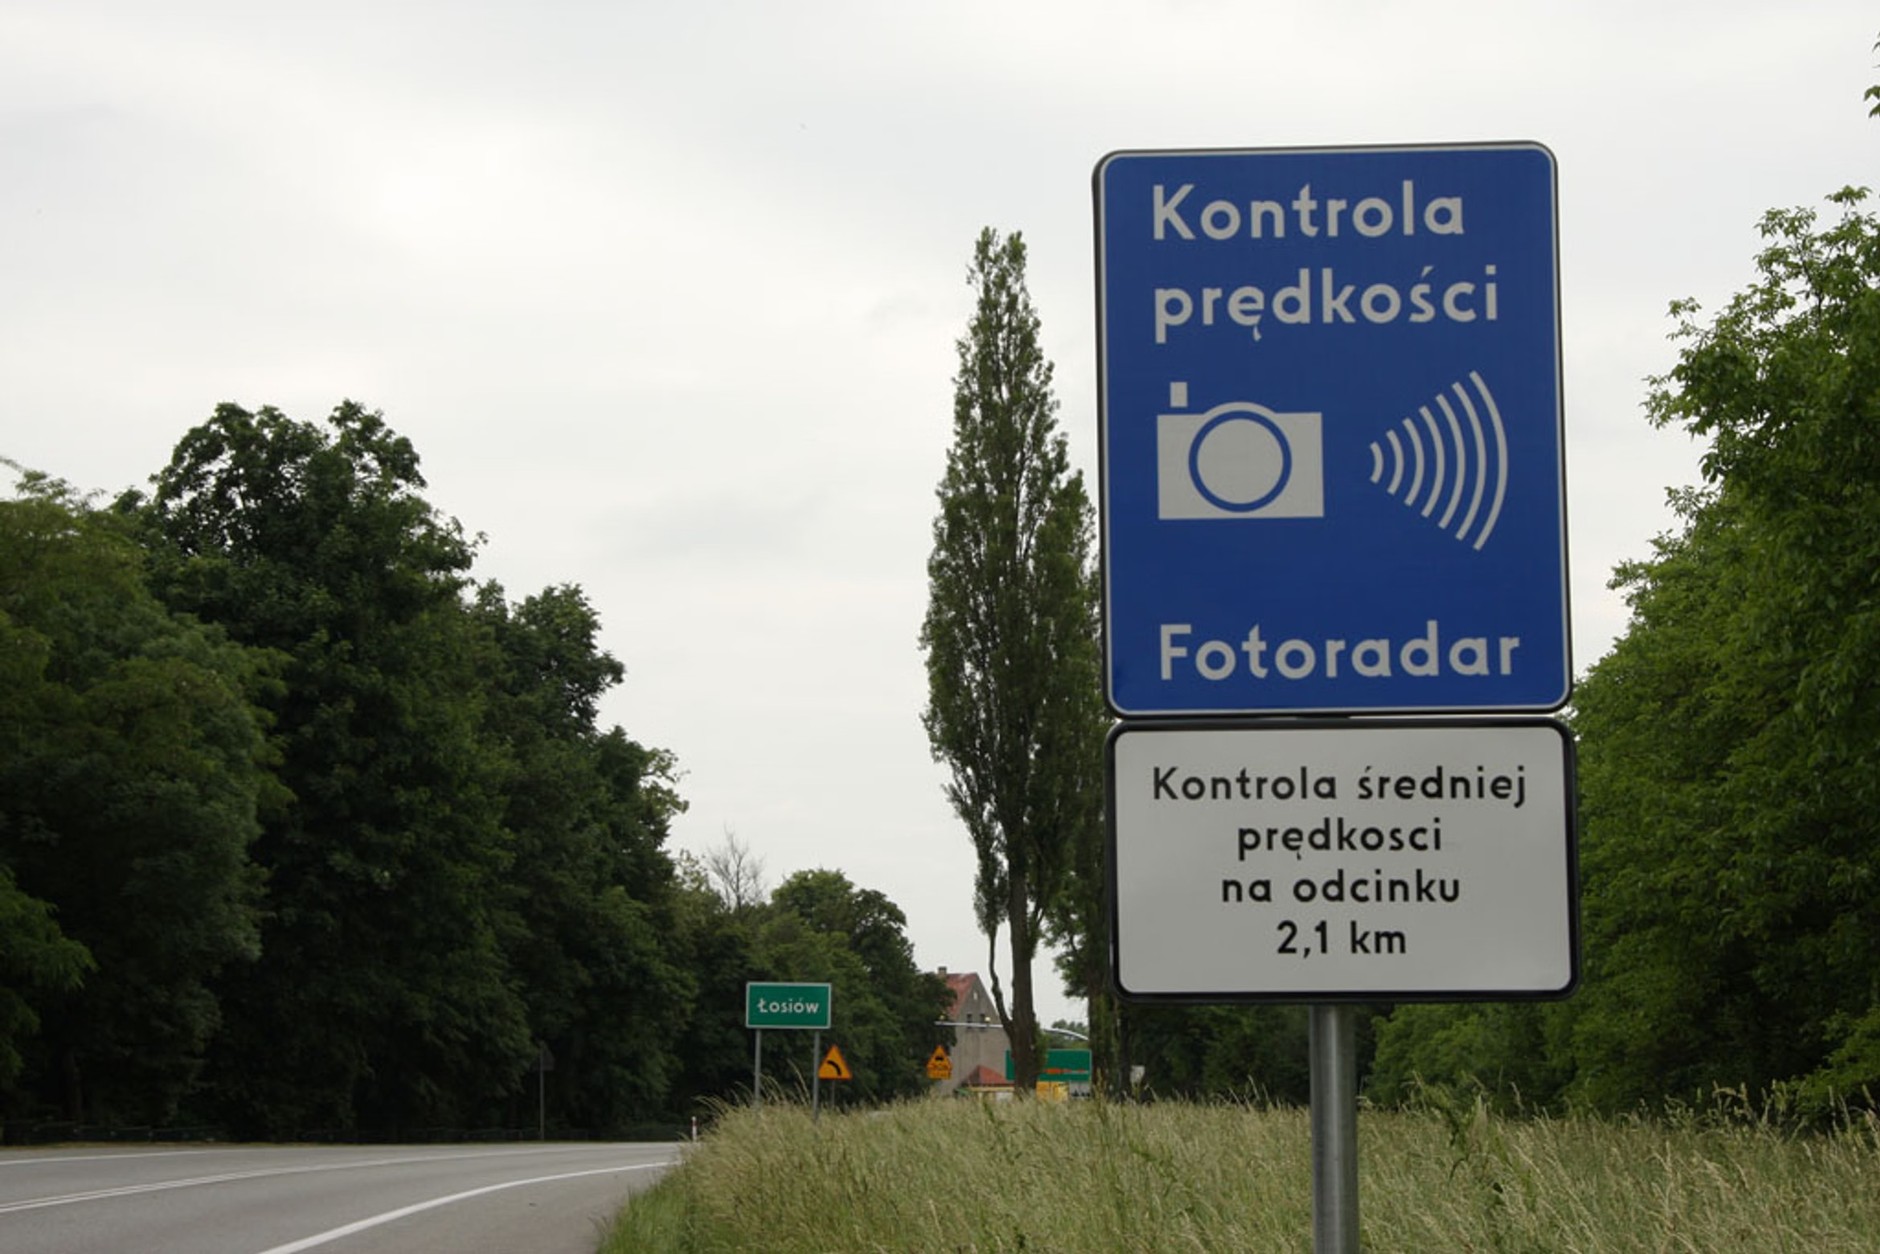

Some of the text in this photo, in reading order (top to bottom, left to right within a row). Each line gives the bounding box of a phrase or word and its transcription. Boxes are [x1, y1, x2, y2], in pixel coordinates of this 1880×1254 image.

[1153, 180, 1464, 240] Kontrola
[1155, 265, 1497, 343] prędkości
[1161, 620, 1520, 680] Fotoradar
[1153, 766, 1525, 808] Kontrola średniej
[1238, 818, 1441, 861] prędkosci
[1222, 869, 1461, 902] na odcinku
[1277, 920, 1407, 958] 2,1 km
[757, 998, 819, 1013] Łosiów
